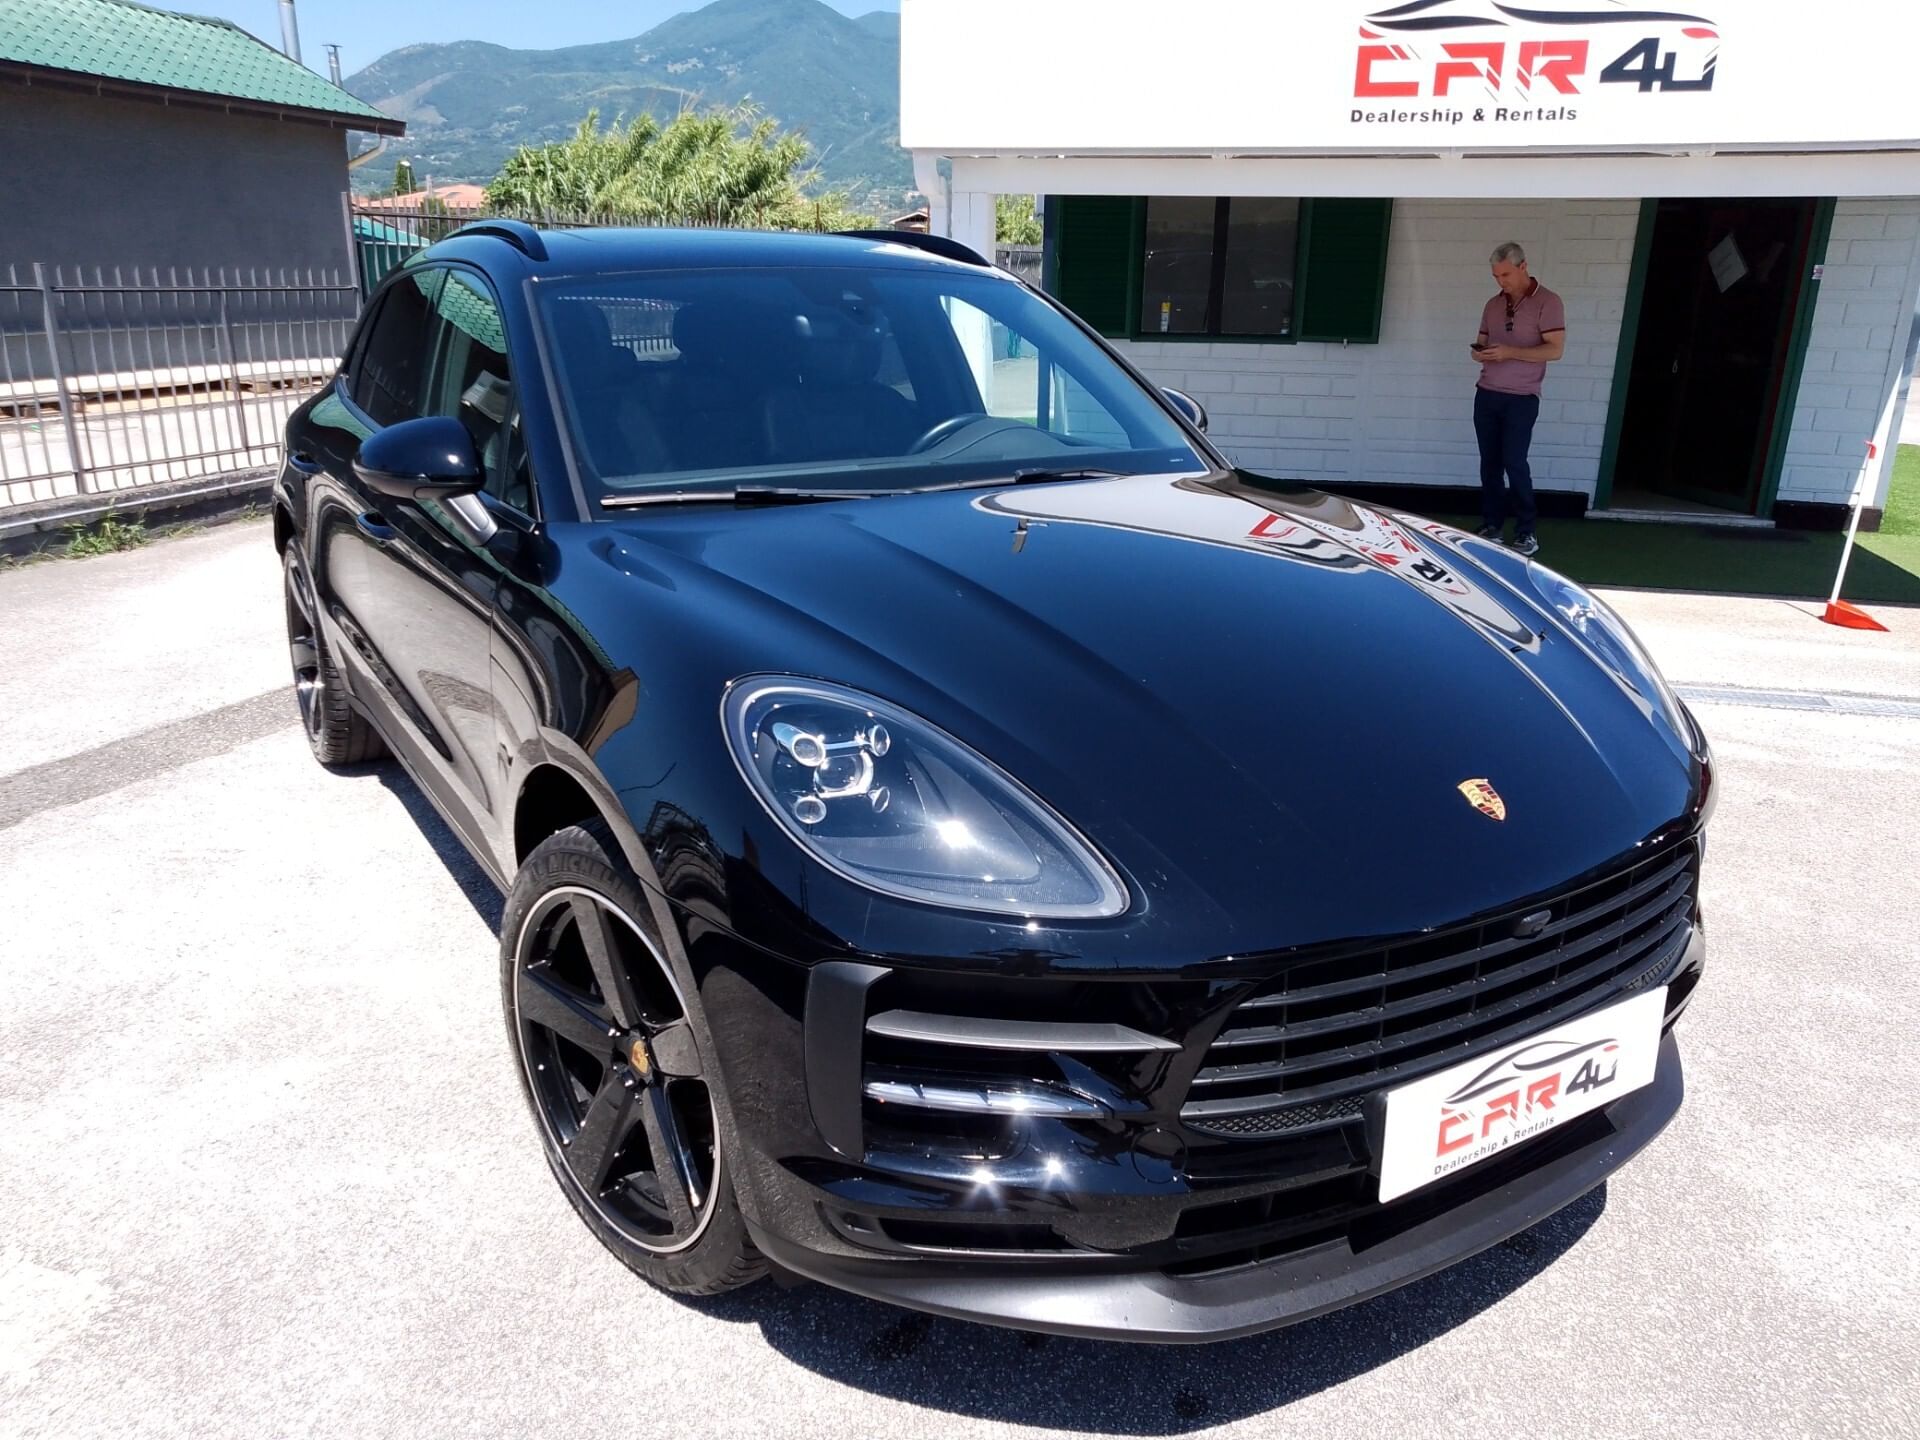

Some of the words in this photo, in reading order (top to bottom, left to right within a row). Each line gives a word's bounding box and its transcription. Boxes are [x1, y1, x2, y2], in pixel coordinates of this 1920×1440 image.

[1353, 40, 1589, 98] CAR
[1350, 108, 1464, 126] Dealership
[1472, 108, 1486, 122] &
[1495, 106, 1578, 122] Rentals
[1434, 1141, 1498, 1176] Dealership
[1502, 1135, 1509, 1146] &
[1513, 1116, 1556, 1141] Rentals
